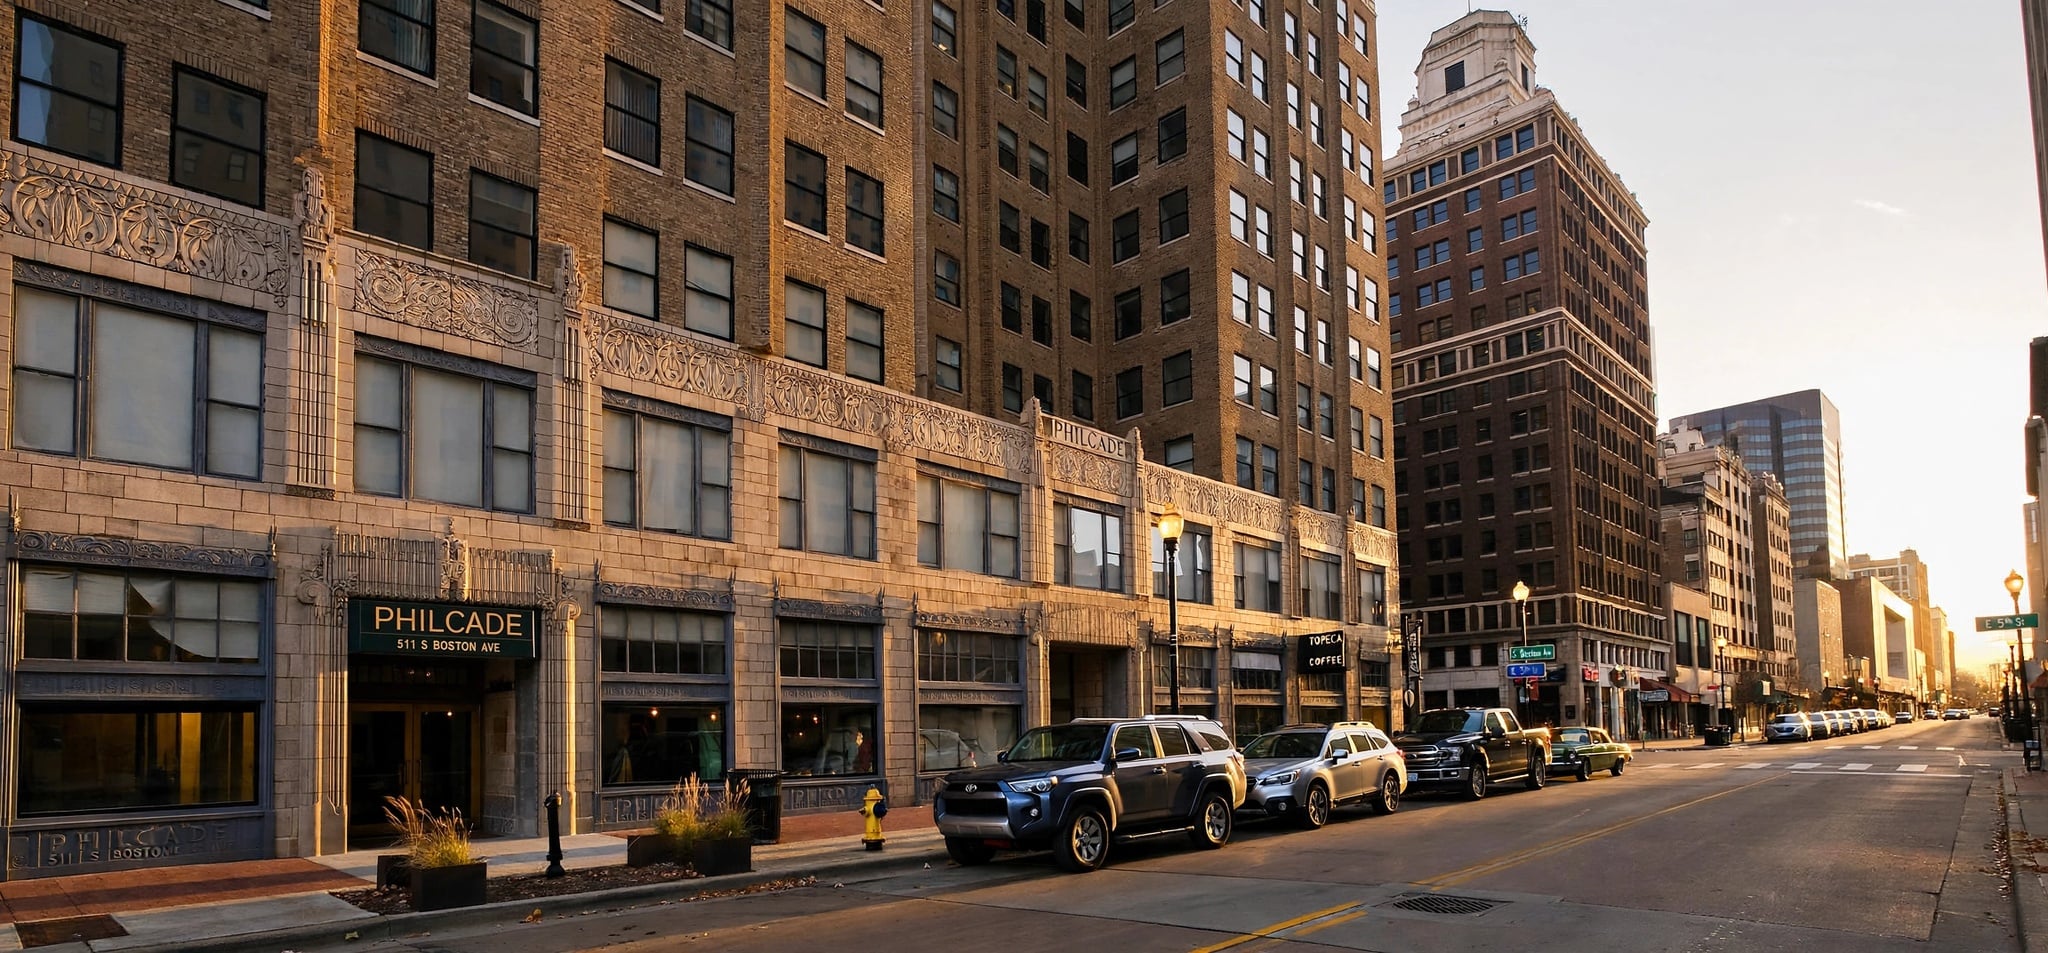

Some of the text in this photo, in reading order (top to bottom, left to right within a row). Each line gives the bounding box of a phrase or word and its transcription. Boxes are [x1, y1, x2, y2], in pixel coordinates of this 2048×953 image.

[1054, 421, 1124, 457] PHILCADE
[375, 606, 523, 636] PHILCADE
[1985, 619, 1992, 629] E
[397, 639, 500, 653] 511 S BOSTON AVE
[1309, 634, 1342, 646] TOPECA
[1309, 655, 1342, 666] COFFEE
[91, 850, 99, 861] S
